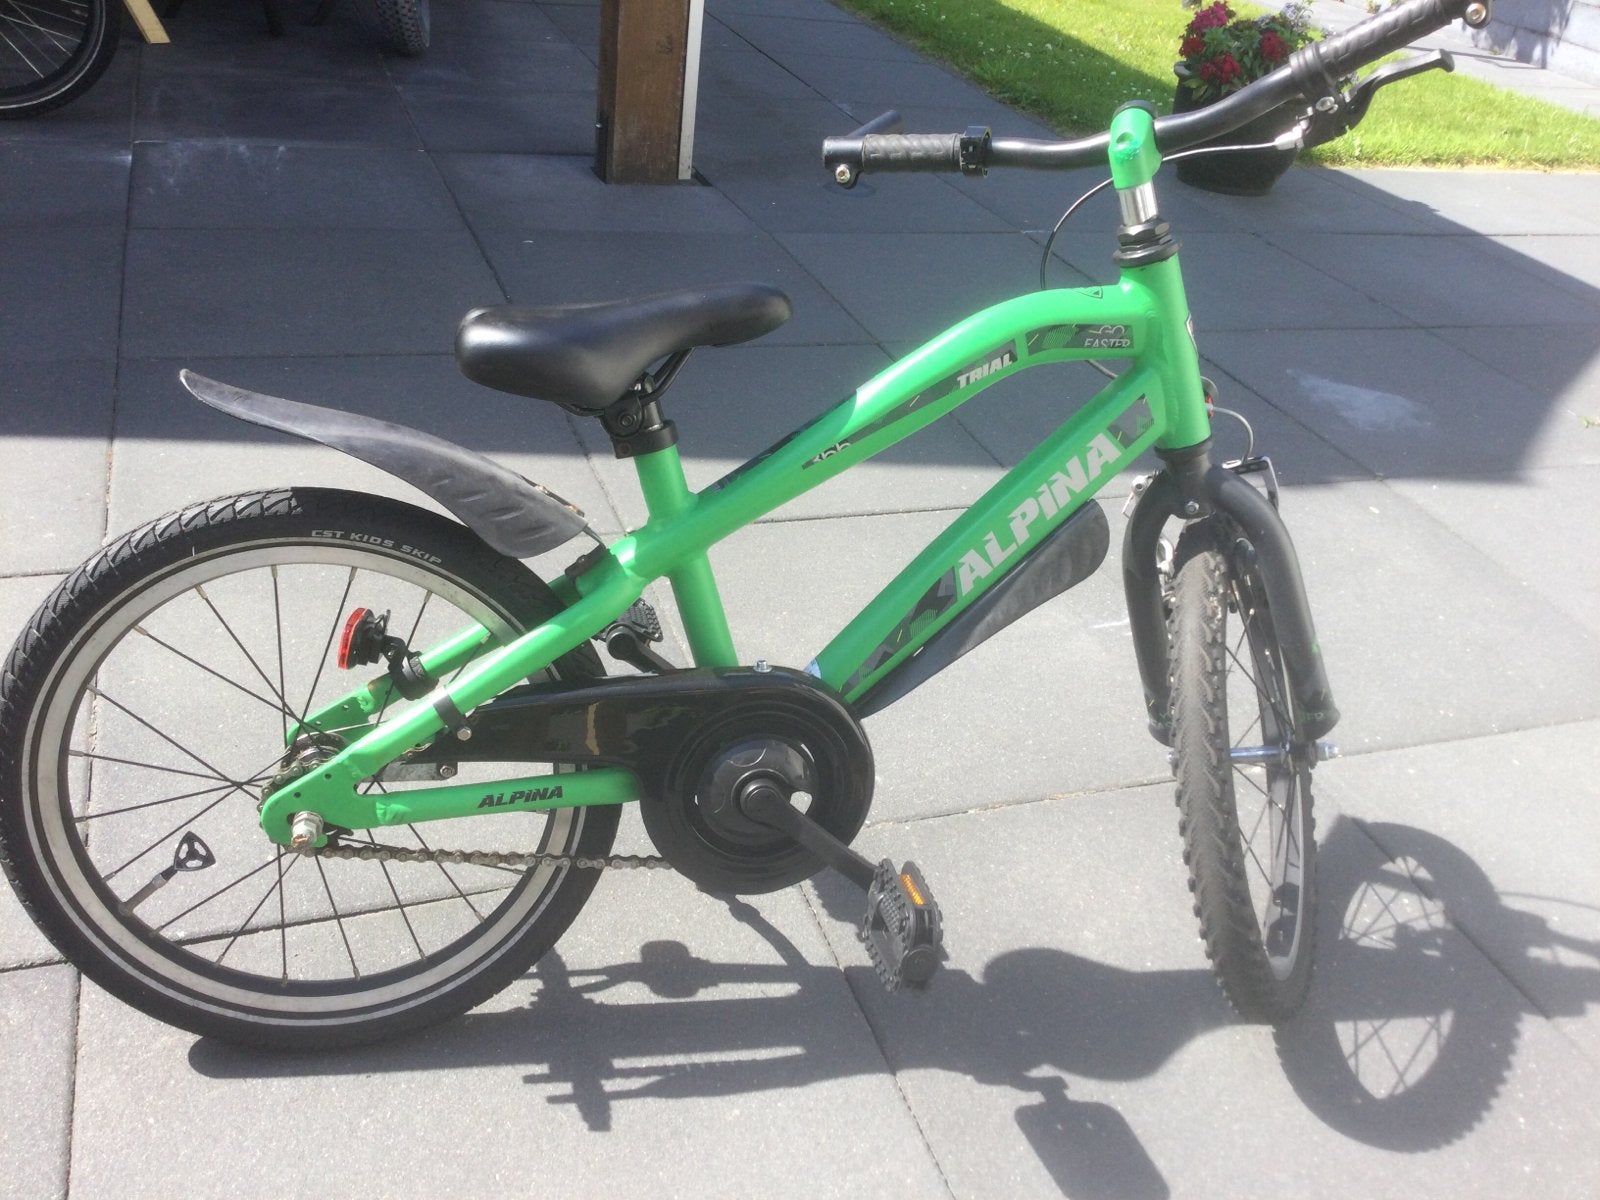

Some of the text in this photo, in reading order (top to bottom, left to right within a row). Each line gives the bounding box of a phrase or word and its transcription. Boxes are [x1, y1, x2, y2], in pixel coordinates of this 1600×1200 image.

[956, 353, 1013, 389] TRIAL
[958, 433, 1122, 597] ALPINA
[311, 529, 442, 564] CST KIDS SKIP
